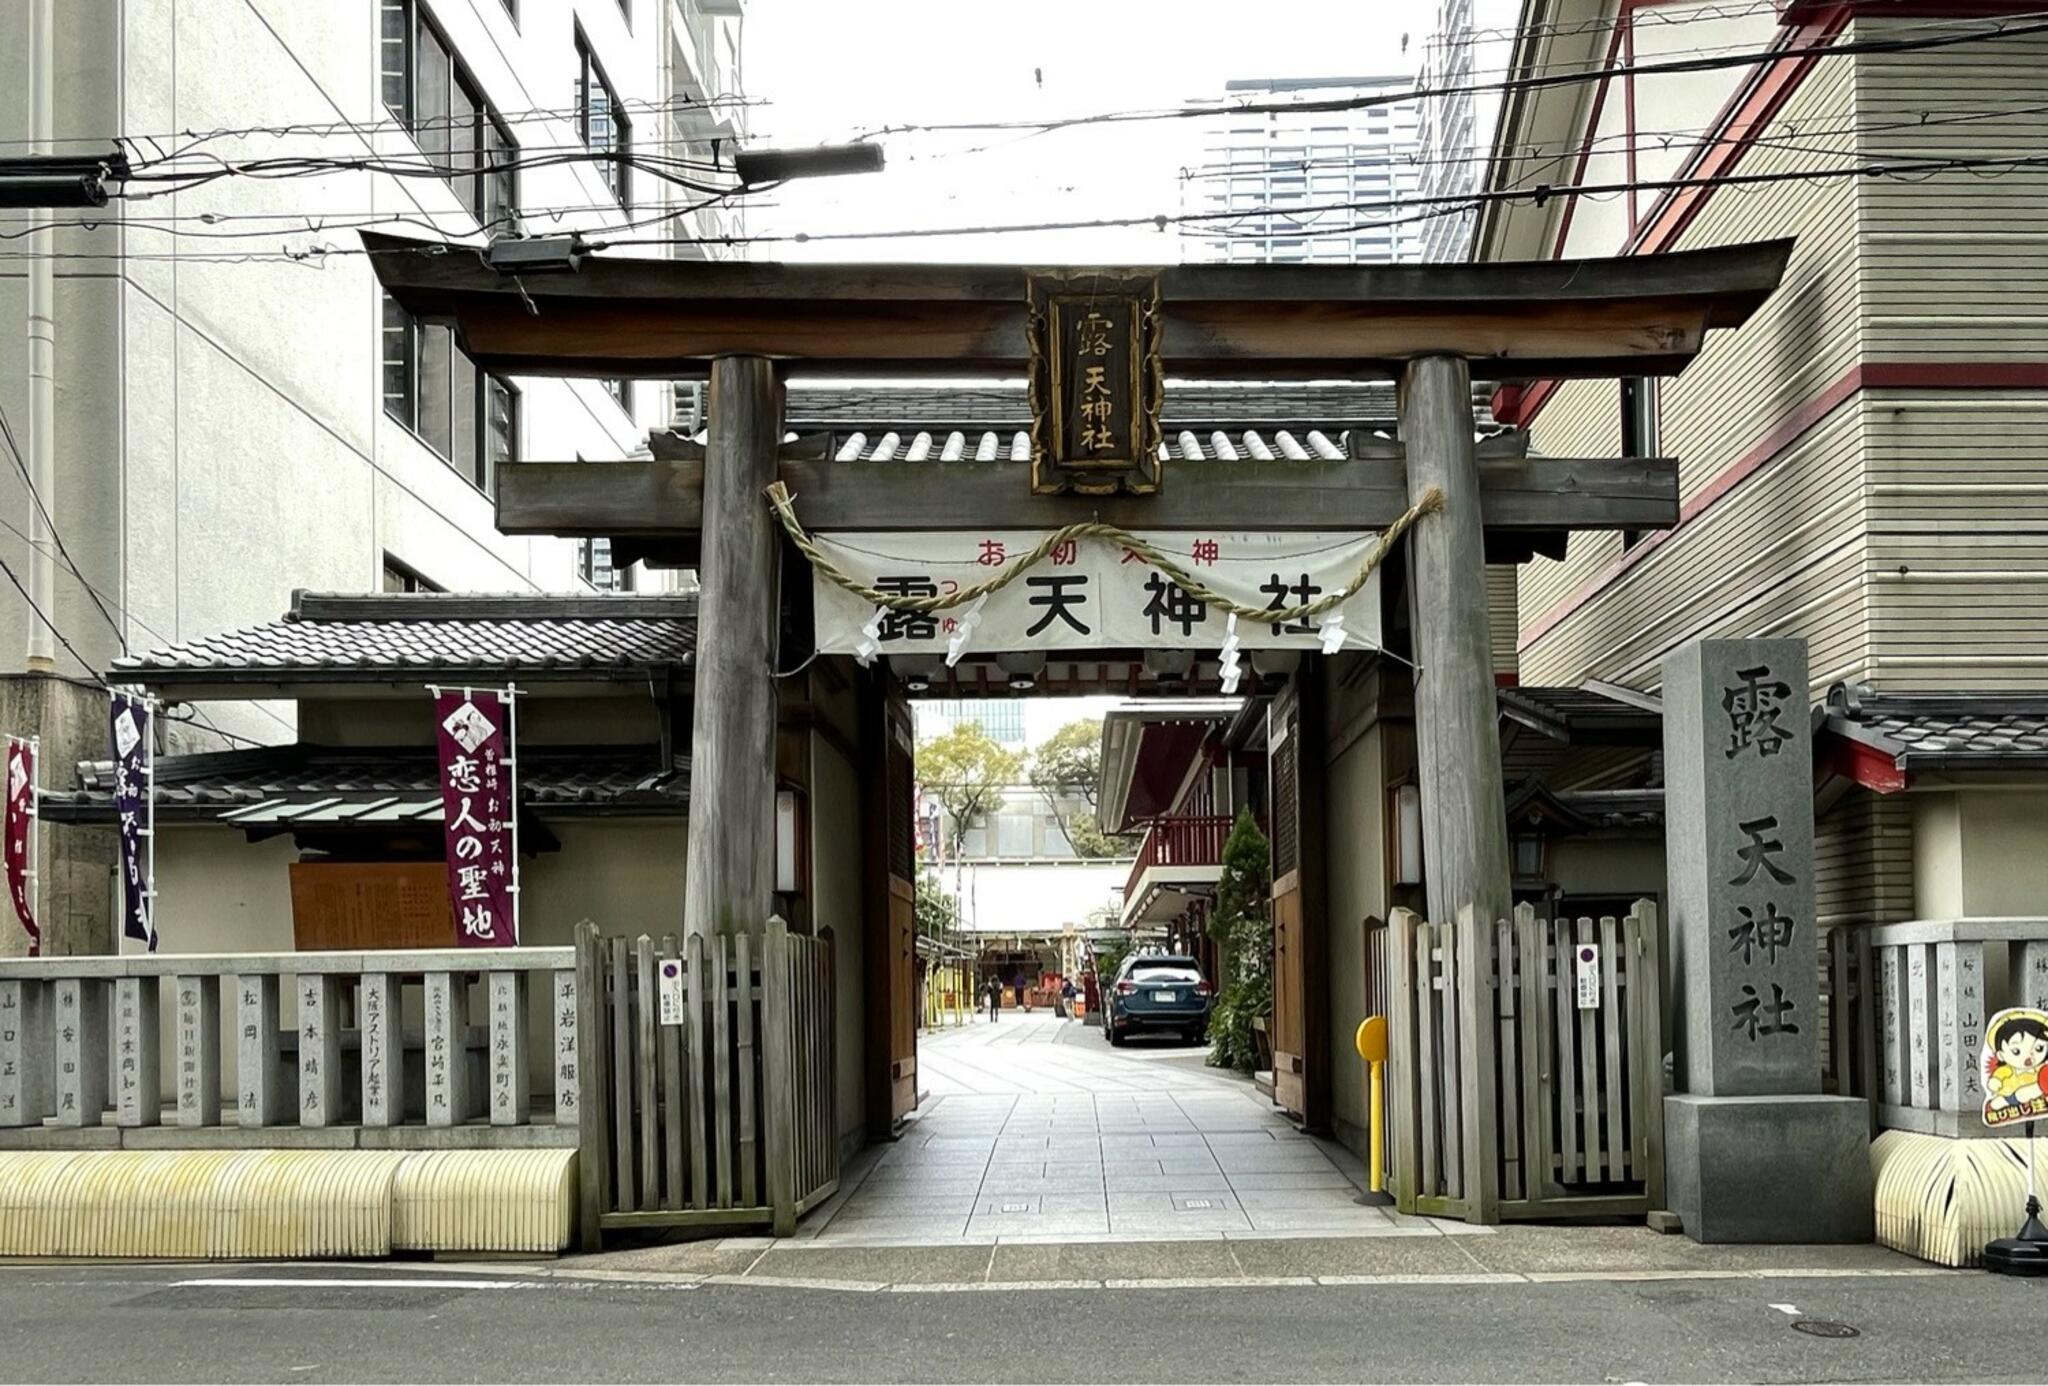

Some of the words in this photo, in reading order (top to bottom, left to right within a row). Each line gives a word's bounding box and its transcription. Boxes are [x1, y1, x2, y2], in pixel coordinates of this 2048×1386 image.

[1076, 313, 1115, 450] 露天神社
[873, 572, 1322, 641] 露天神社
[447, 755, 495, 939] 恋人の聖地
[1722, 665, 1799, 1042] 露天神社
[559, 983, 576, 1107] 平岩洋服店
